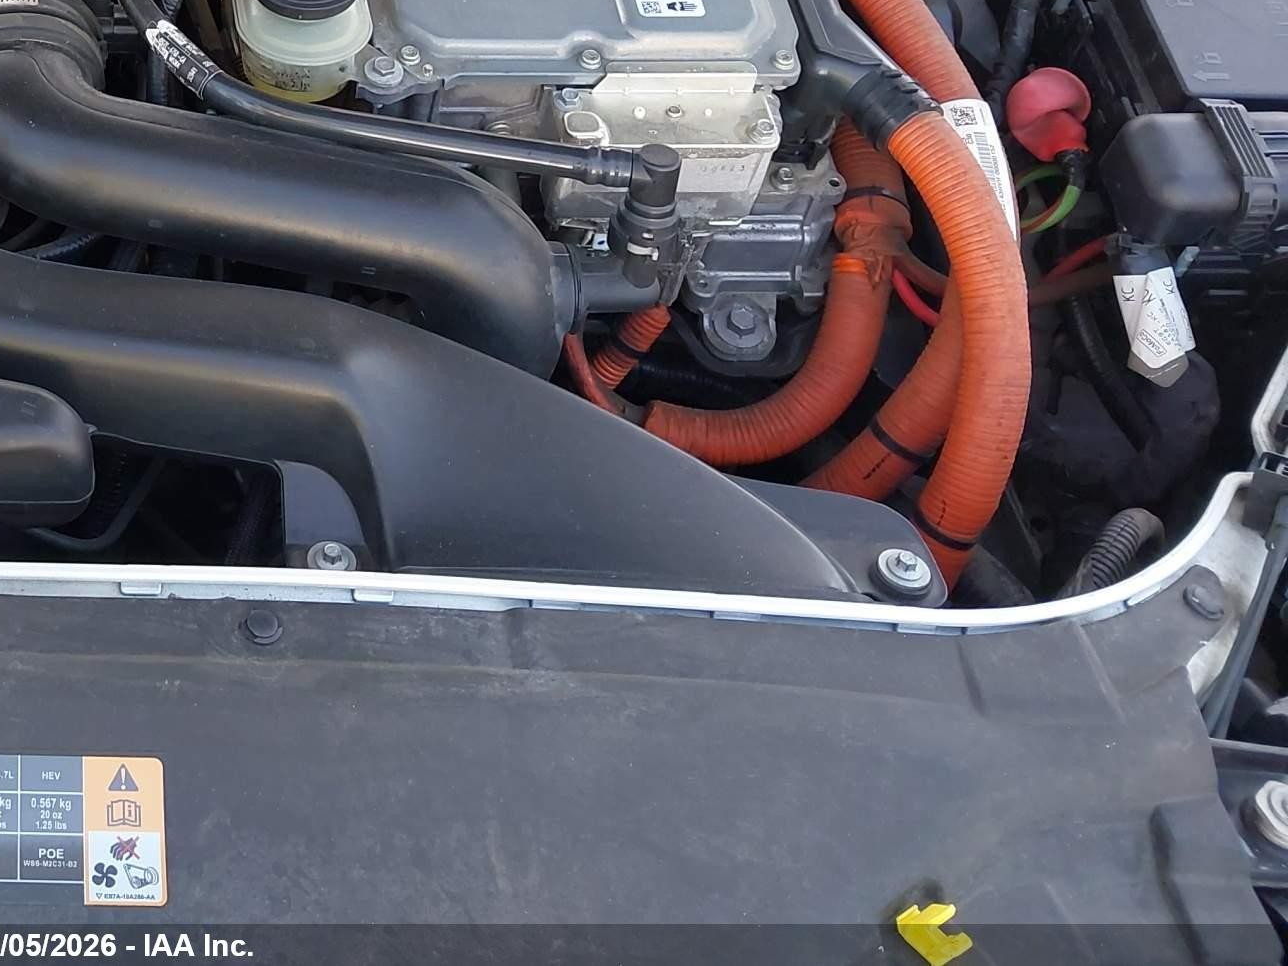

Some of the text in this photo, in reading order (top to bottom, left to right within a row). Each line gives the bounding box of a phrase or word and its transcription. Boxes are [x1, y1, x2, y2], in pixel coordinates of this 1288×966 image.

[1163, 279, 1176, 295] KC
[1121, 286, 1136, 302] KC
[42, 772, 61, 780] HEV
[0, 797, 12, 809] kg
[31, 798, 72, 811] 0.567 kg
[40, 810, 51, 818] 20
[36, 820, 67, 830] 1.25 lbs
[38, 848, 65, 859] POE
